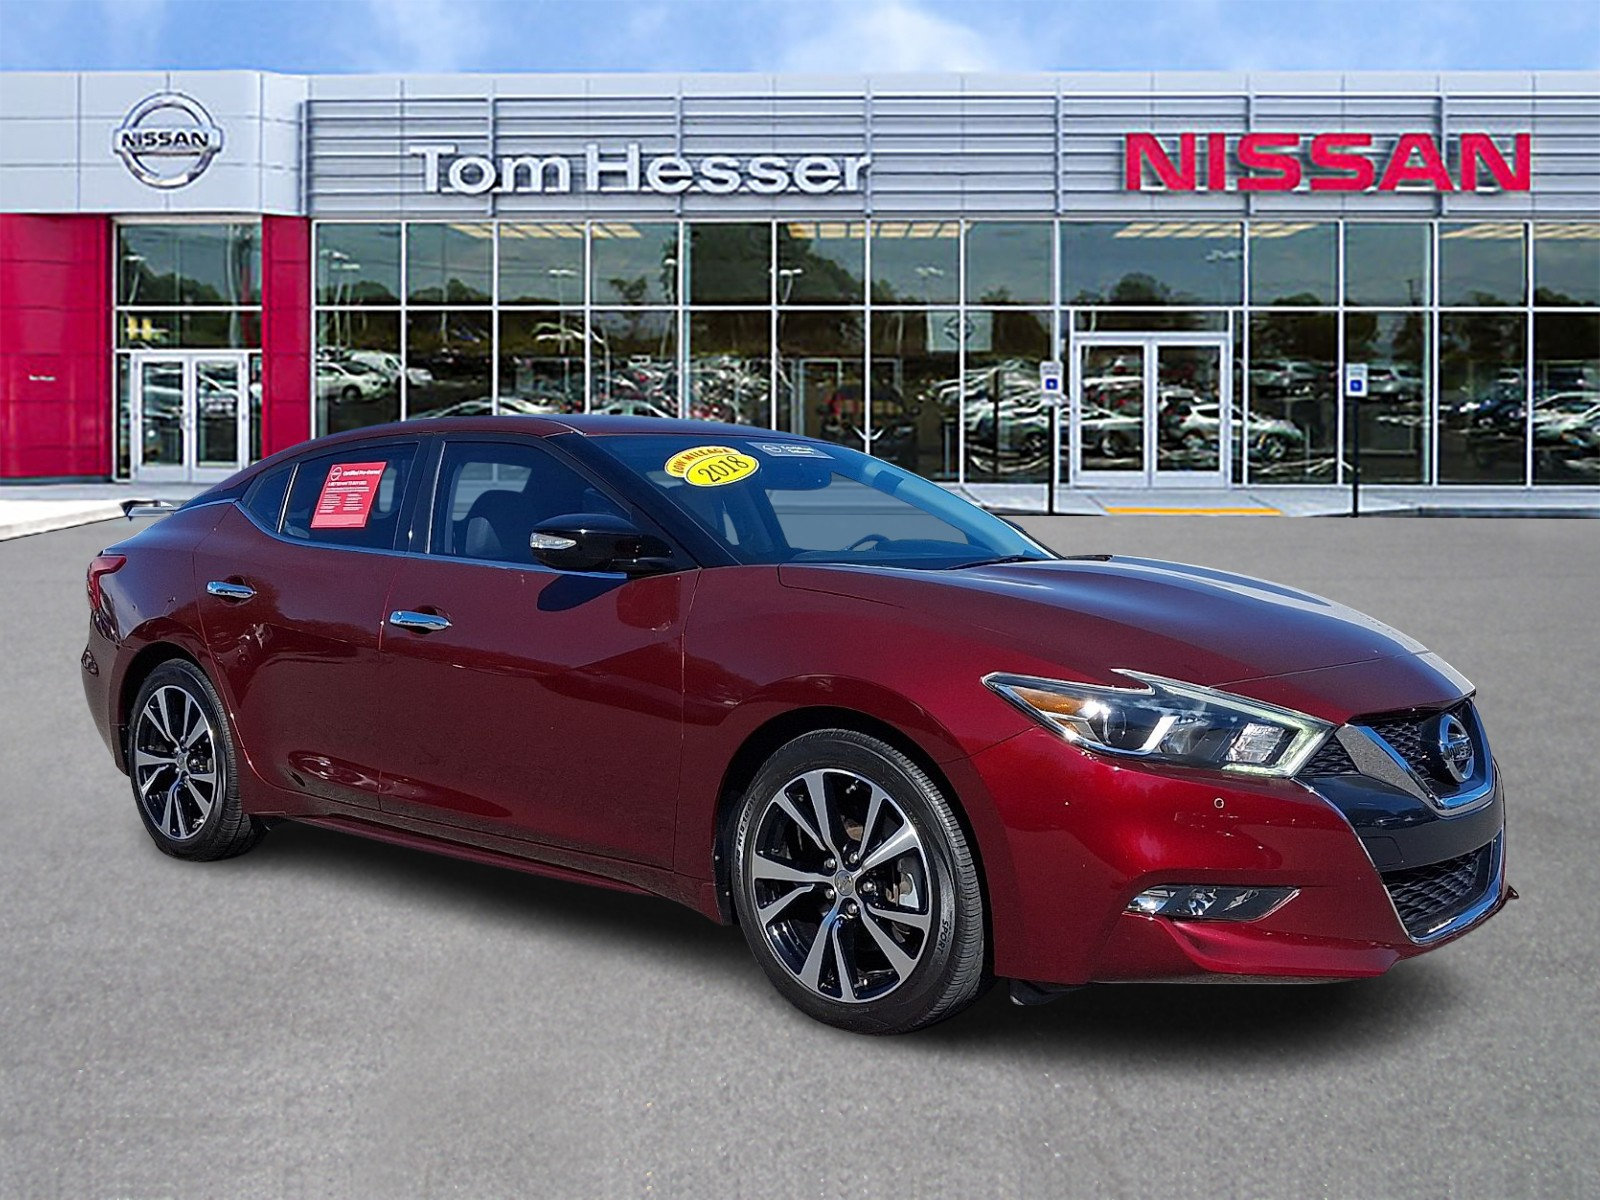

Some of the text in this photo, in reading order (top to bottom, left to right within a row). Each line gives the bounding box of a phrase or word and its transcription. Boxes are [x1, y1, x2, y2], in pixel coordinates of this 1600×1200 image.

[120, 131, 209, 148] NISSAN
[409, 143, 870, 193] Tom Hesser
[1125, 132, 1532, 191] NISSAN
[698, 455, 749, 482] 2018
[937, 919, 949, 954] SPORT
